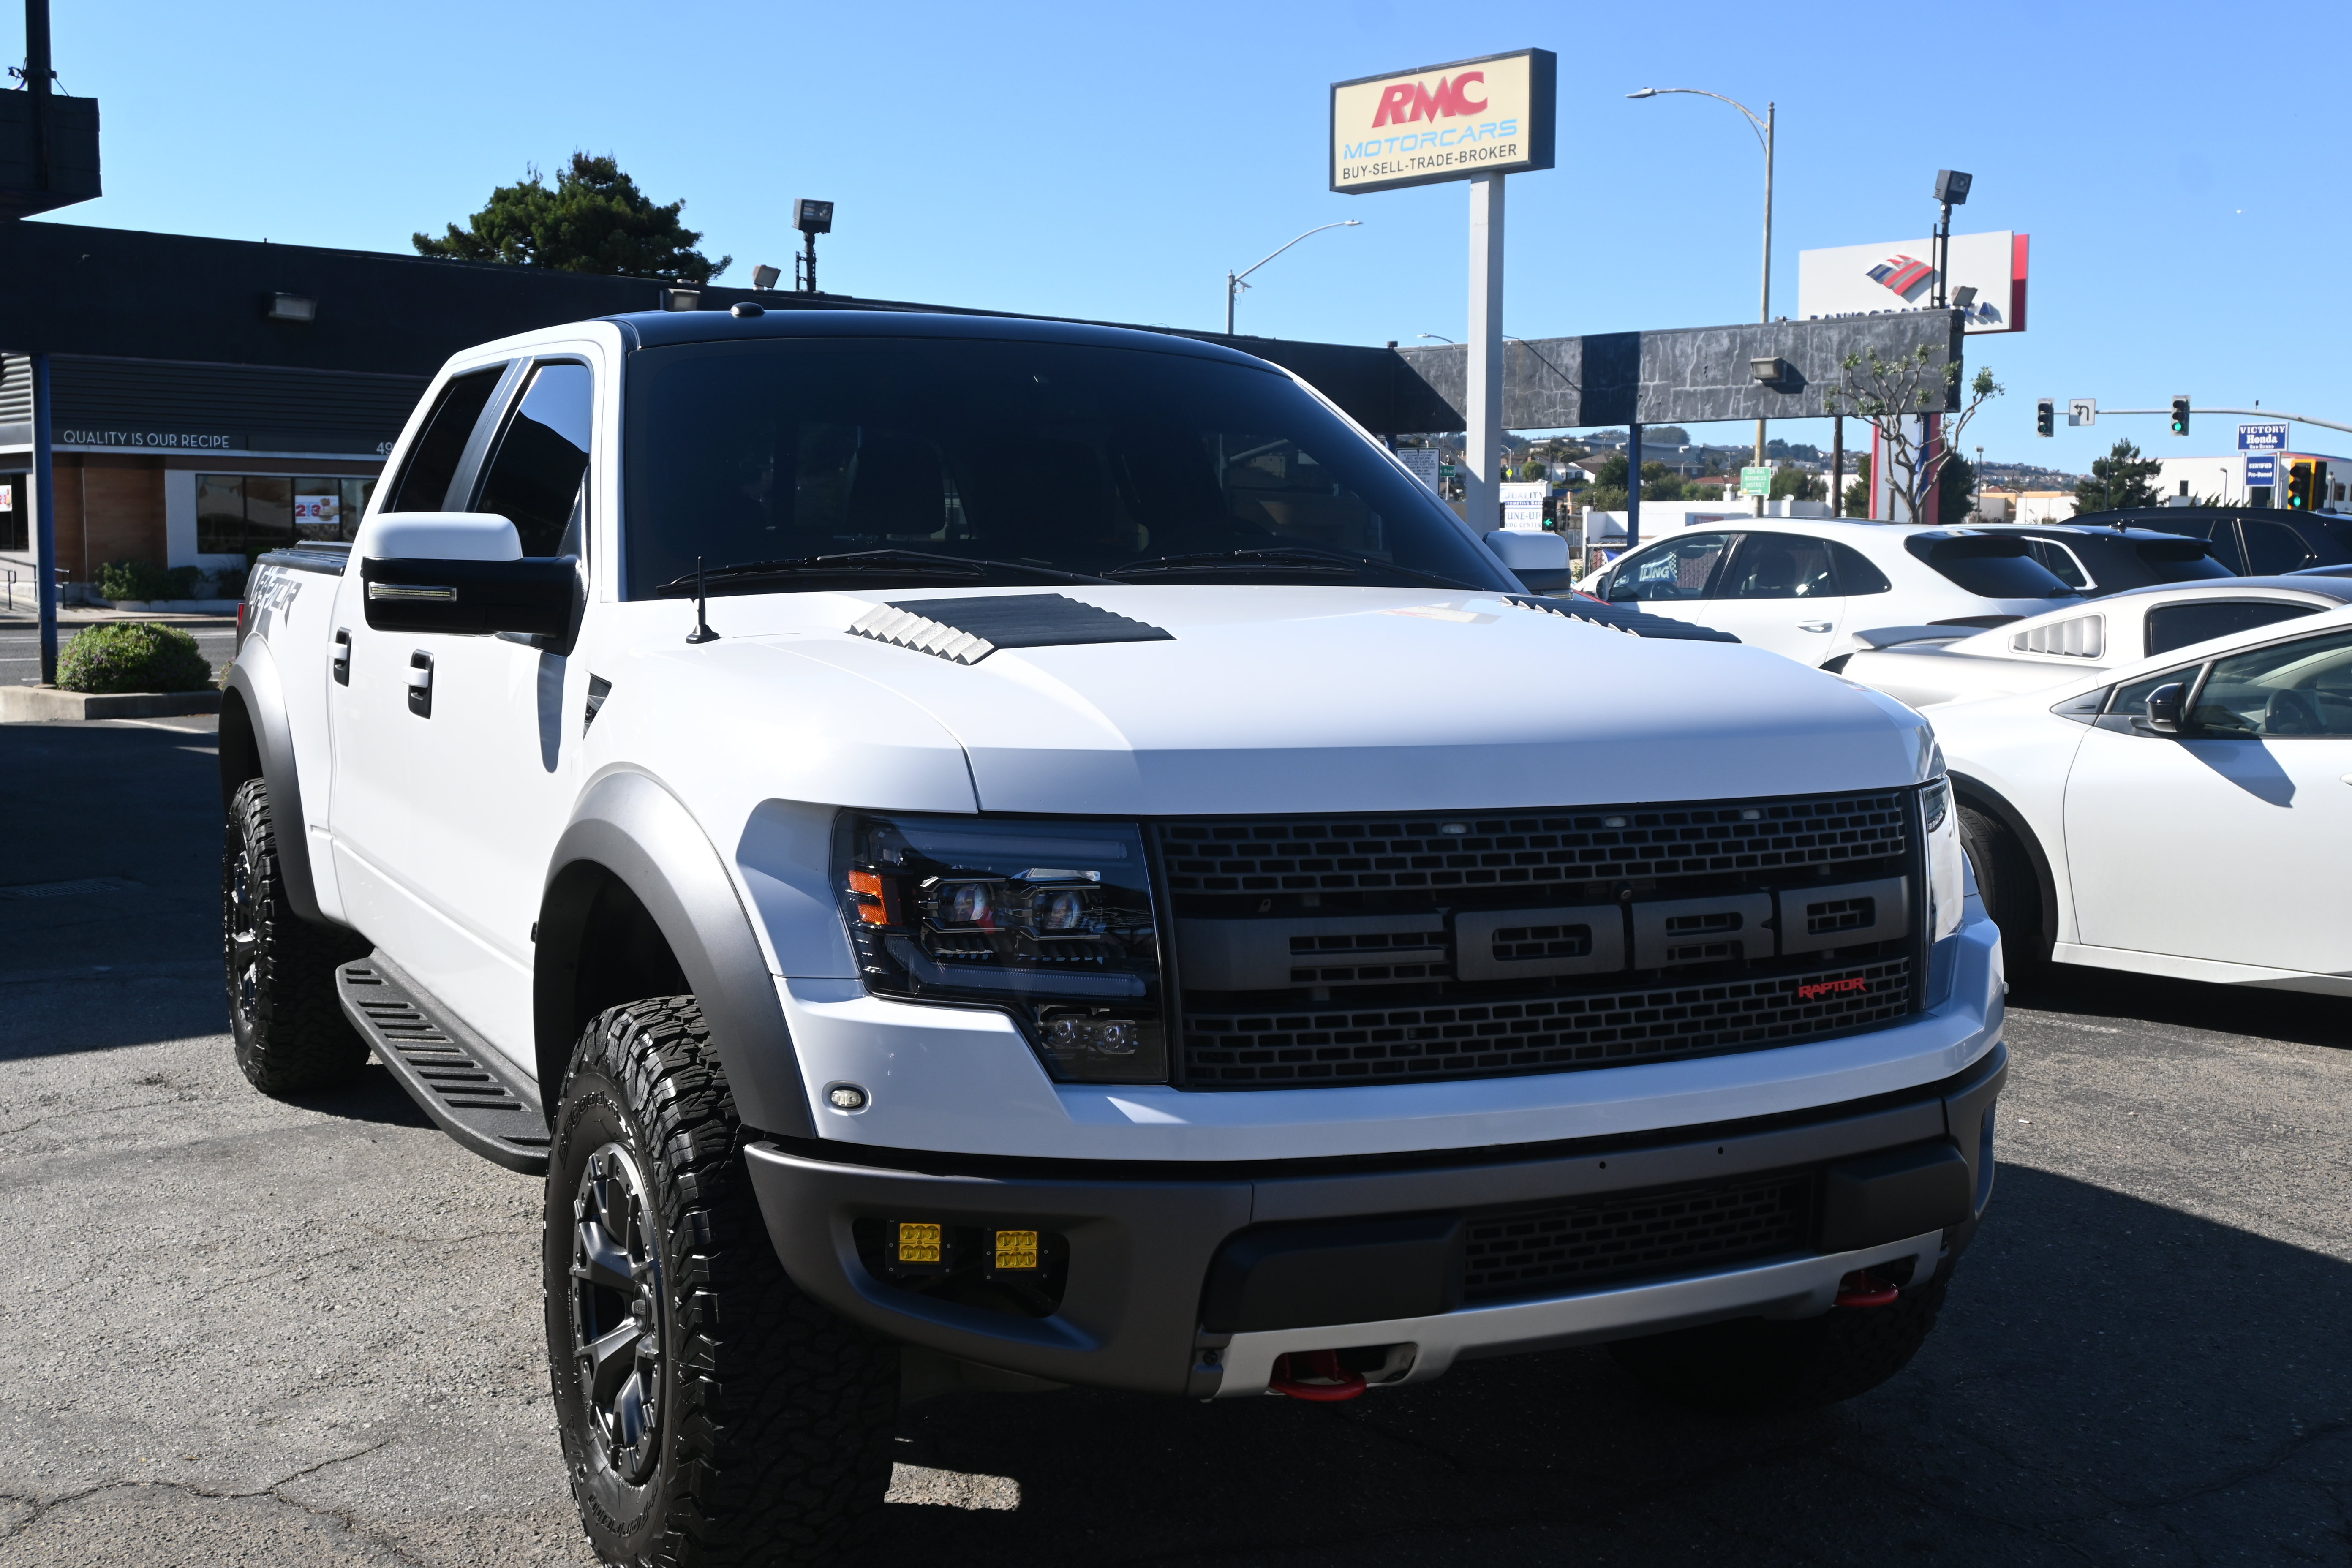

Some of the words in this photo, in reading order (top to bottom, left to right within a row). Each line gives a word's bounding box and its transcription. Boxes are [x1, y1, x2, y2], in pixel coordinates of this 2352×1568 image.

[1372, 71, 1488, 128] RMC
[1344, 119, 1518, 160] MOTORCARS
[1343, 143, 1517, 180] BUY-SELL-TRADE-BROKER
[64, 430, 127, 444] QUALITY
[132, 433, 143, 445] IS
[147, 433, 177, 446] OUR
[182, 434, 229, 448] RECIPE
[2240, 426, 2286, 434] VICTORY
[2246, 434, 2278, 444] Honda
[376, 442, 396, 455] 49
[1506, 512, 1541, 520] UNE-UP
[1174, 877, 1911, 990] FORD
[1799, 977, 1867, 1000] RAPTOR
